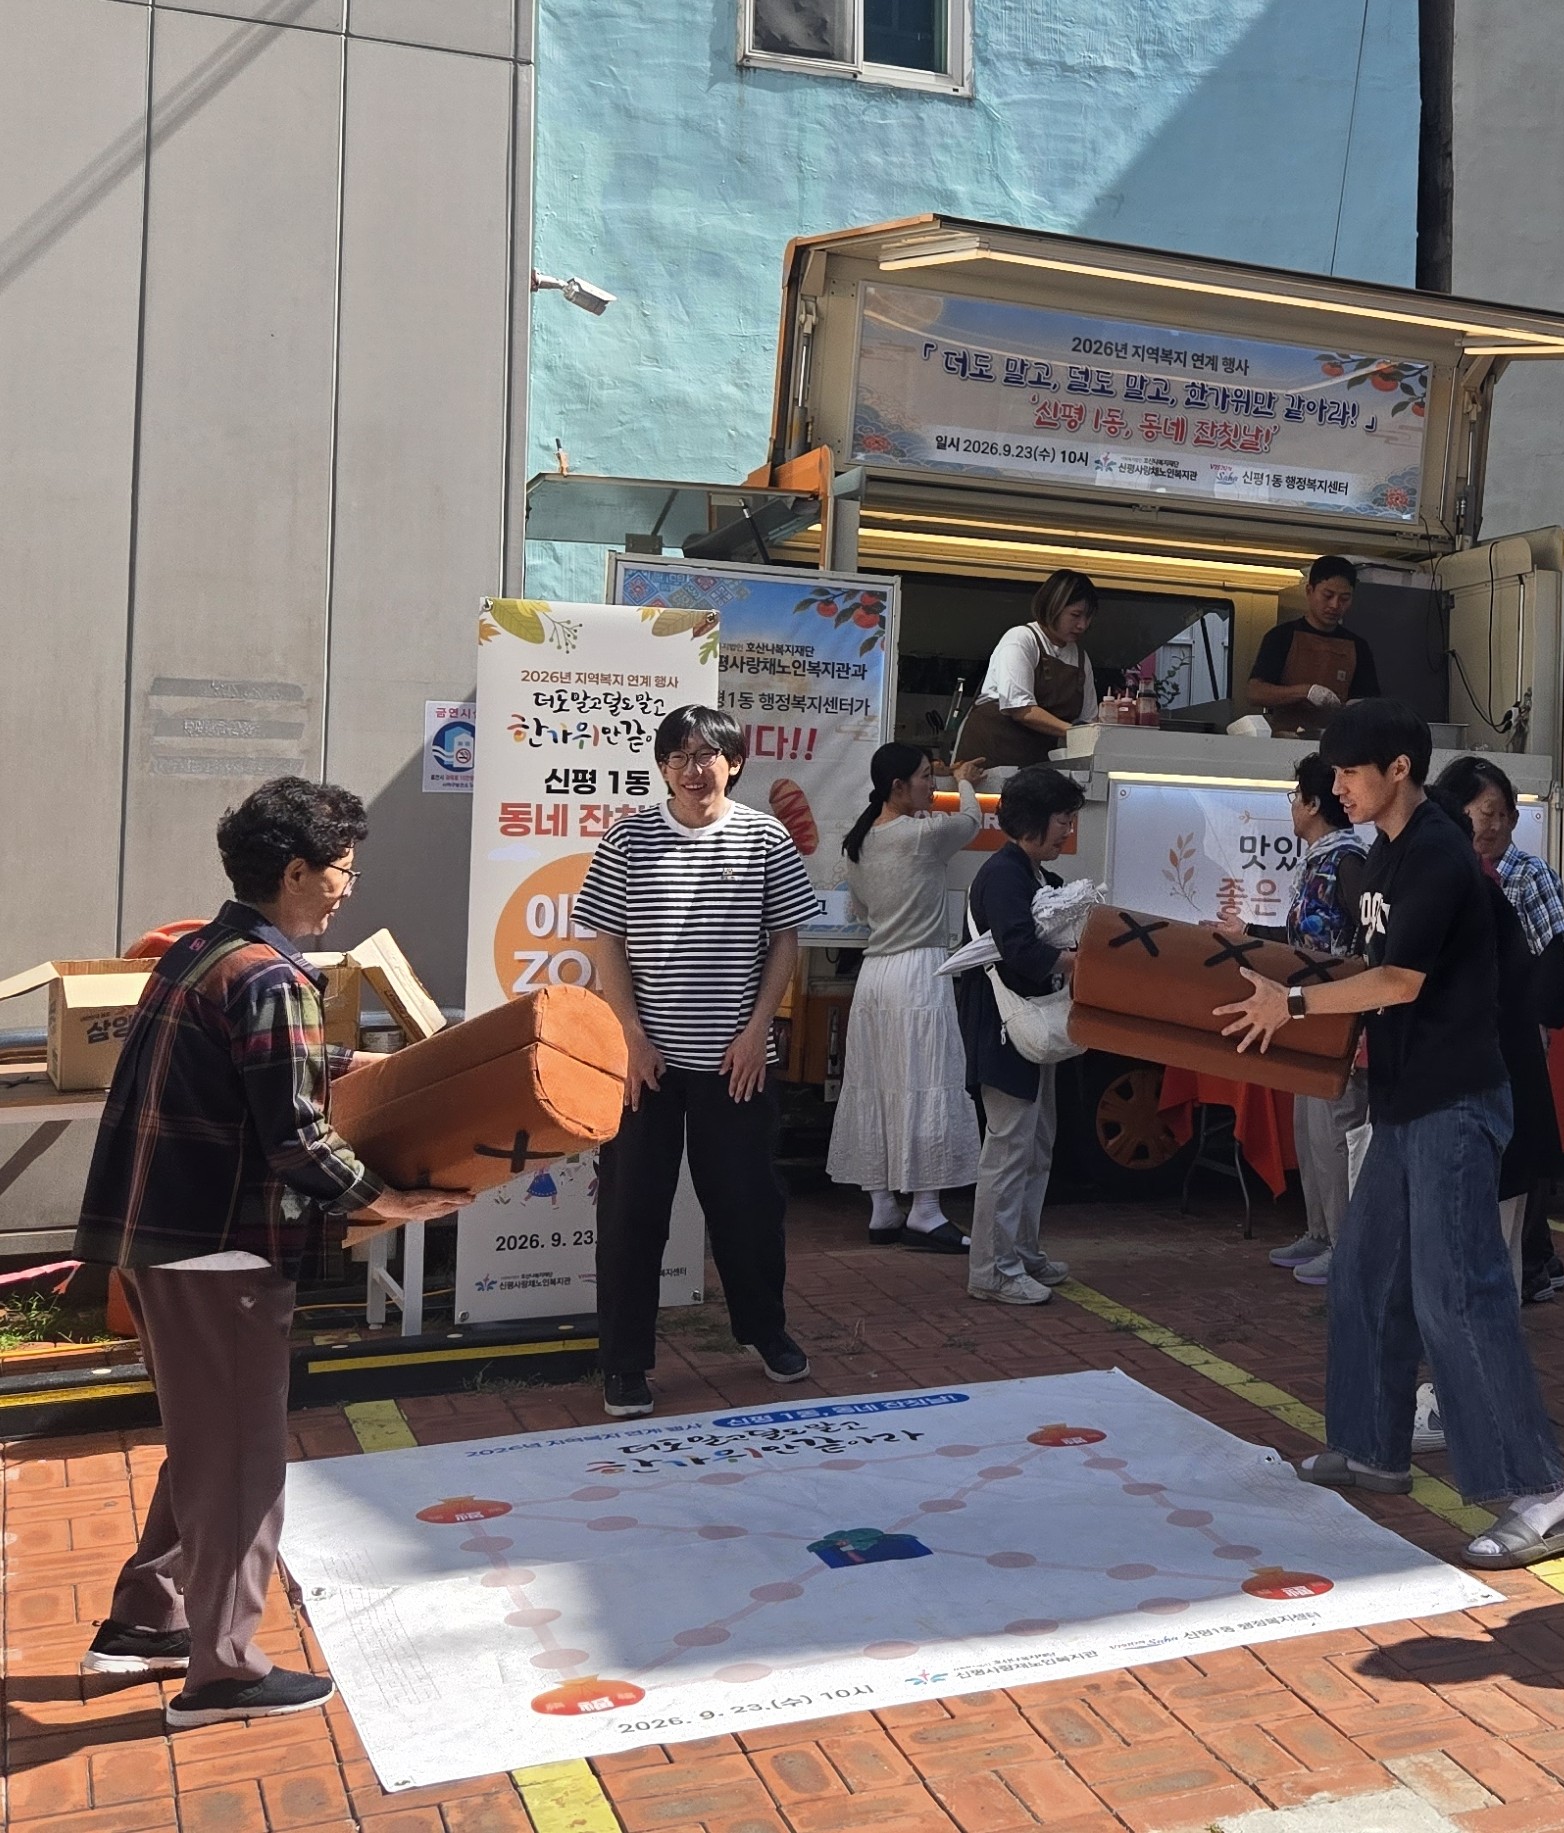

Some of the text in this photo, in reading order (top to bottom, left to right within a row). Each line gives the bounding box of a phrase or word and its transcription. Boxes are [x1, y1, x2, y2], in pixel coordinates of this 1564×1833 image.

[1072, 337, 1250, 376] 2026년 지역복지 연계 행사
[943, 350, 994, 380] 더도
[1003, 358, 1058, 391] 말고,
[1066, 366, 1115, 394] 덜도
[1124, 374, 1176, 406] 말고,
[1185, 382, 1277, 417] 한가위만
[1284, 393, 1358, 428] 같아라!
[1138, 412, 1187, 443] 동네
[935, 435, 1089, 467] 일시 2026.9.23(수) 10시
[1242, 471, 1349, 496] 신평1동 행정복지센터
[746, 642, 815, 658] 호산나복지재단
[521, 670, 679, 689] 2026년 지역복지 연계 행사
[719, 655, 867, 680] 평사랑채노인복지관과
[718, 690, 870, 716] 1동 행정복지센터가
[545, 768, 650, 796] 신평 1동
[499, 803, 568, 837] 동네
[1240, 835, 1302, 871] 맛있
[513, 950, 603, 993] ZO
[496, 1234, 545, 1251] 2026.
[551, 1232, 567, 1247] 9.
[727, 1414, 774, 1426] 신평
[779, 1407, 829, 1420] 1동,
[833, 1403, 879, 1415] 동네
[1183, 1611, 1322, 1640] 신평1동 행정복지센터
[618, 1685, 874, 1734] 2026. 9. 23.(수) 10시
